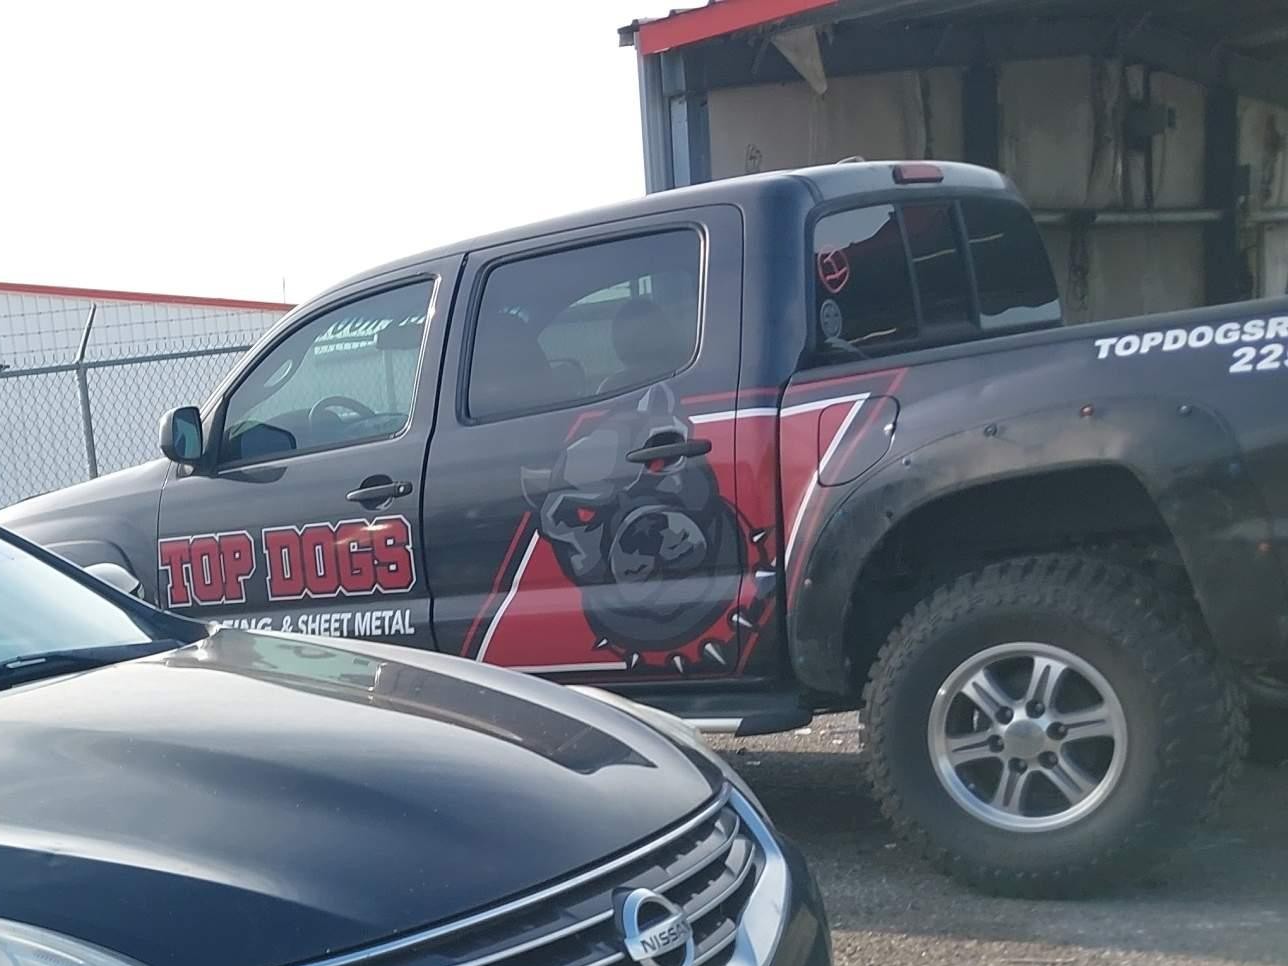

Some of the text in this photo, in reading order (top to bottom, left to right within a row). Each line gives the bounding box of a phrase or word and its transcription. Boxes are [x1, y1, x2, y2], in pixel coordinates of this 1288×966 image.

[1228, 343, 1288, 373] 22
[158, 514, 416, 608] TOP DOGS
[281, 615, 294, 633] &
[298, 612, 353, 637] SHEET
[354, 609, 415, 637] METAL
